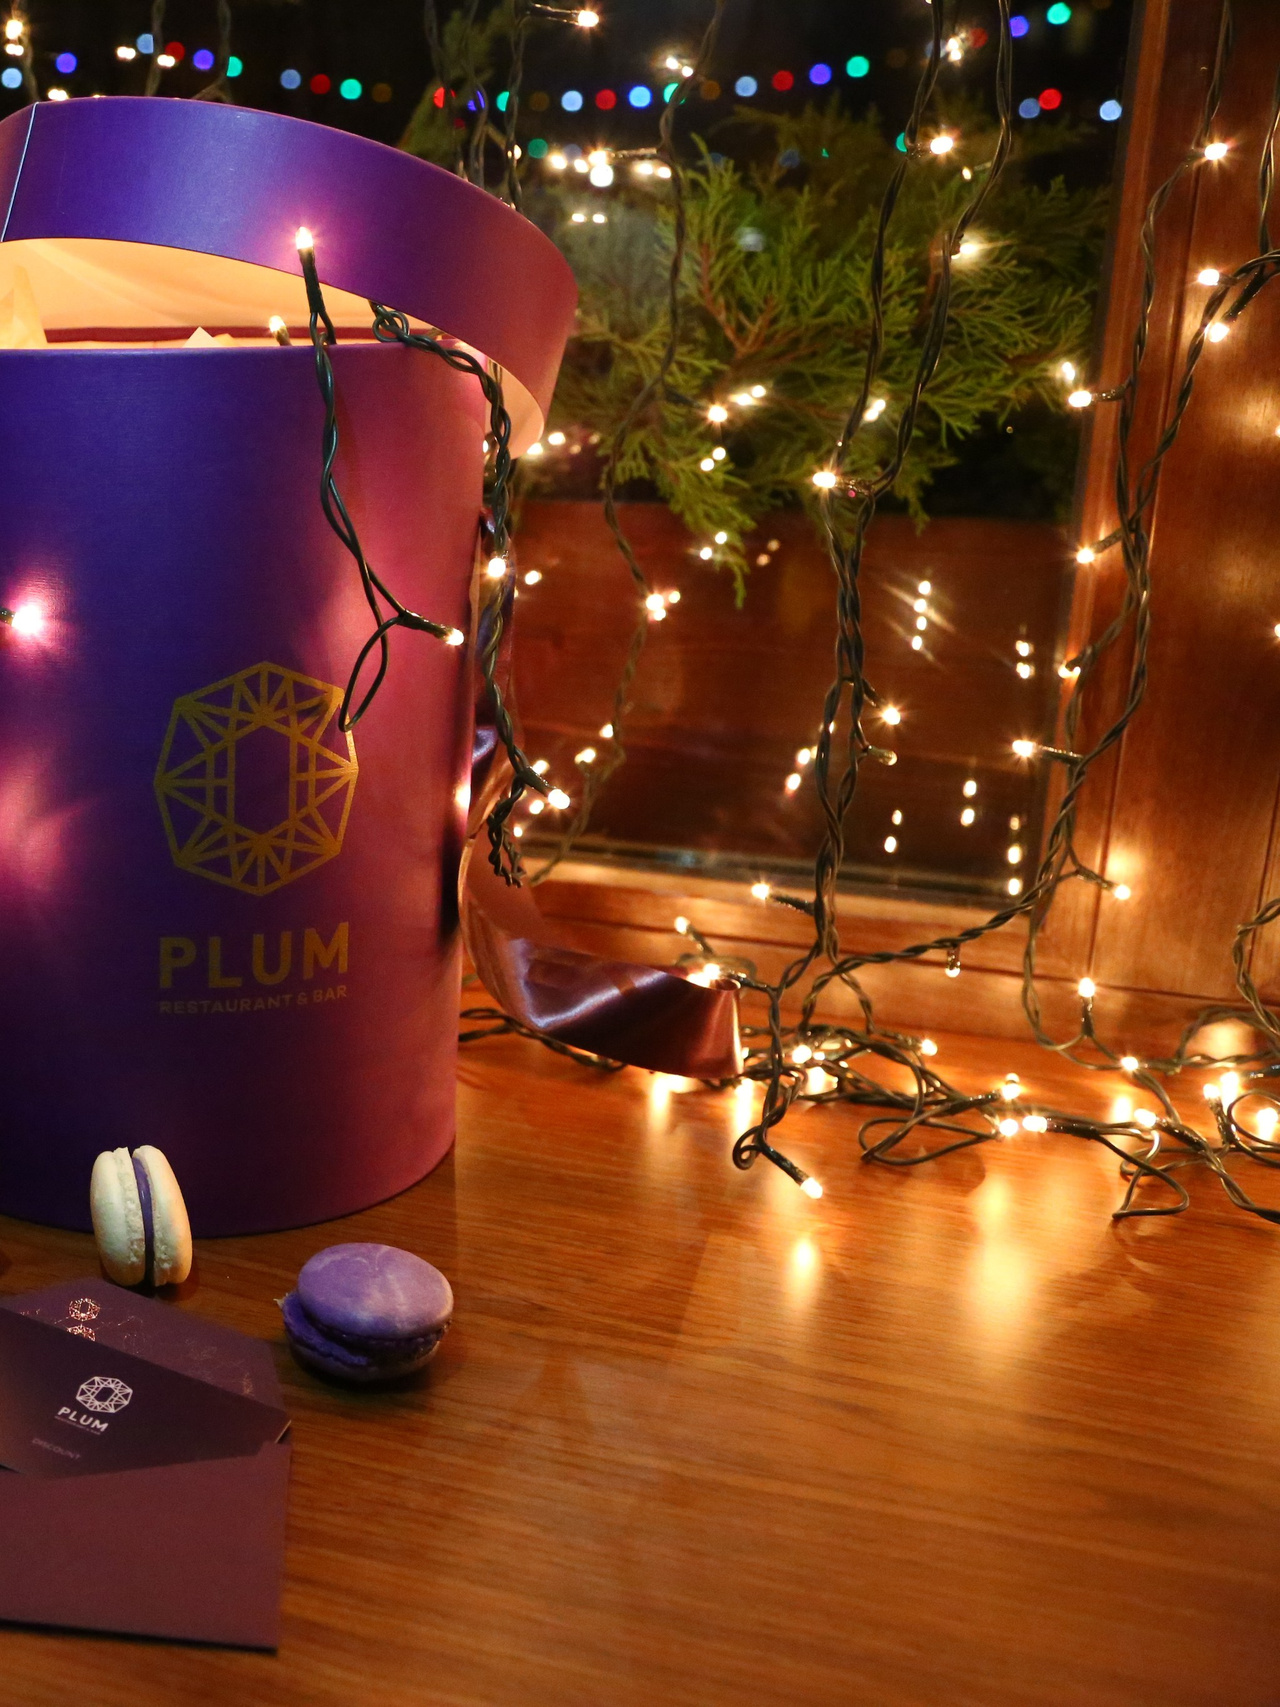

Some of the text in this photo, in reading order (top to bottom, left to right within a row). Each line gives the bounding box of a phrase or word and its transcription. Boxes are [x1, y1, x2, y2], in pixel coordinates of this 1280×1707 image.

[158, 921, 349, 988] PLUM
[158, 984, 348, 1014] RESTAURANT & BAR
[57, 1406, 109, 1433] PLUM
